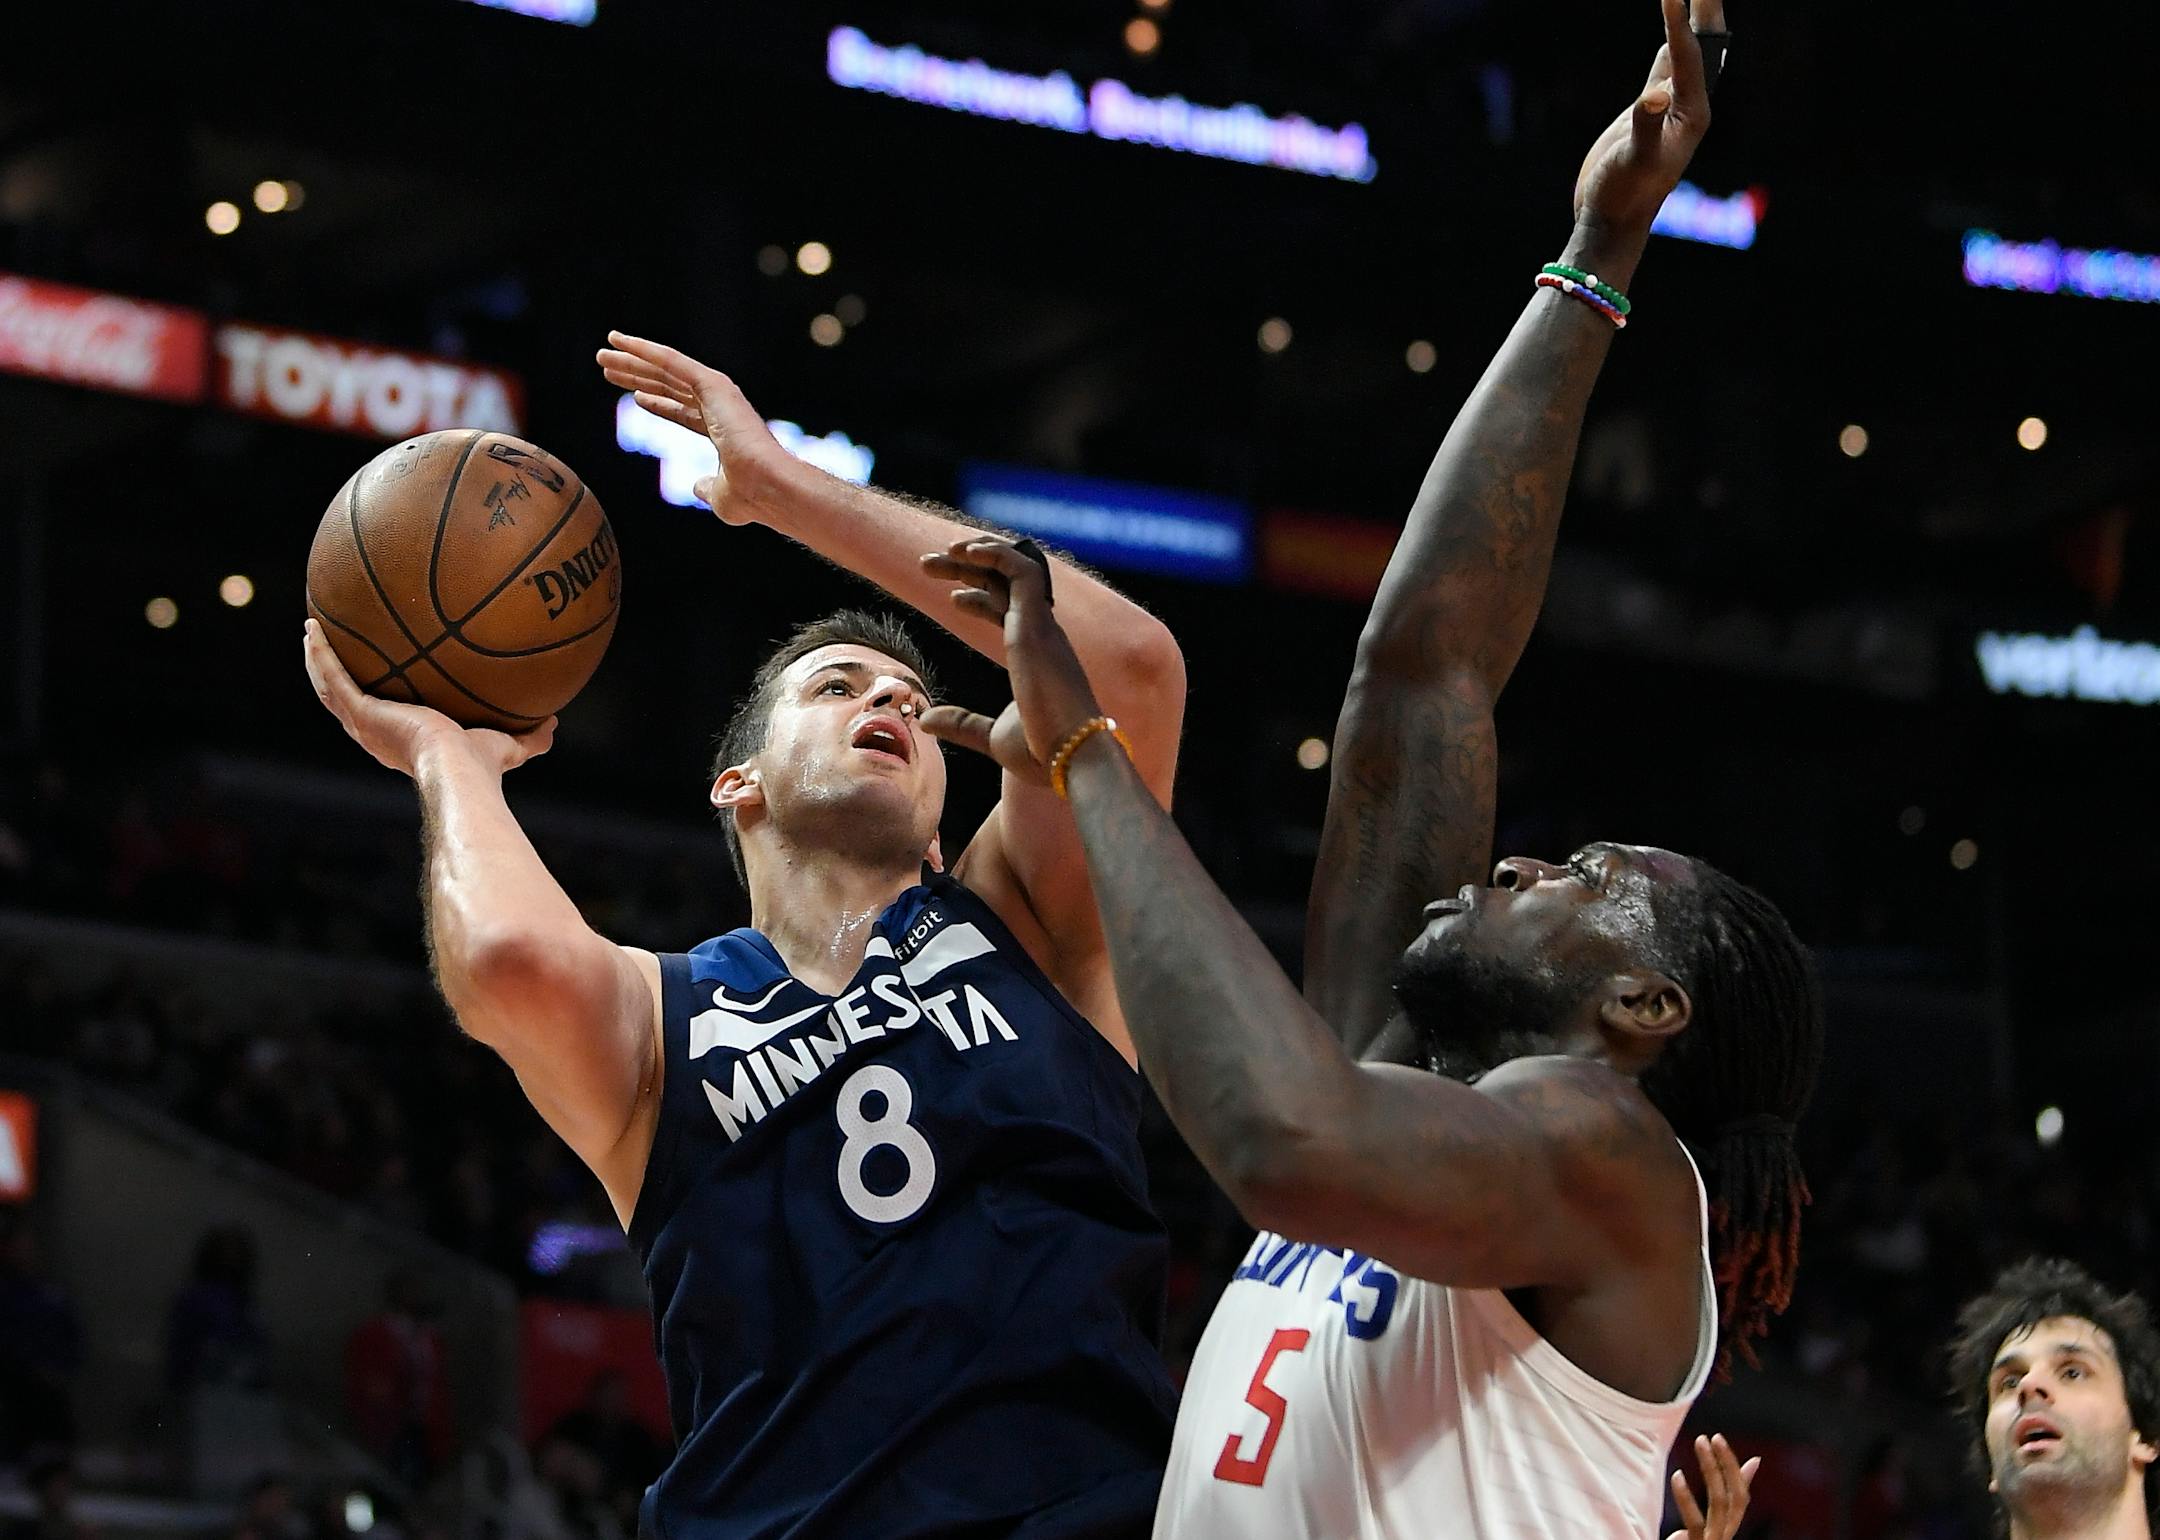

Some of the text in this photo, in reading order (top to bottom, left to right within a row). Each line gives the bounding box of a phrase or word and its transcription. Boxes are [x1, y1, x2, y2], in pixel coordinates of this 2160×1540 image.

[221, 327, 519, 437] TOYOTA
[1976, 624, 2160, 706] verizo
[895, 911, 944, 960] fitbit
[701, 974, 1019, 1143] MINNESTA
[836, 1064, 936, 1224] 8
[1213, 1328, 1310, 1487] 5
